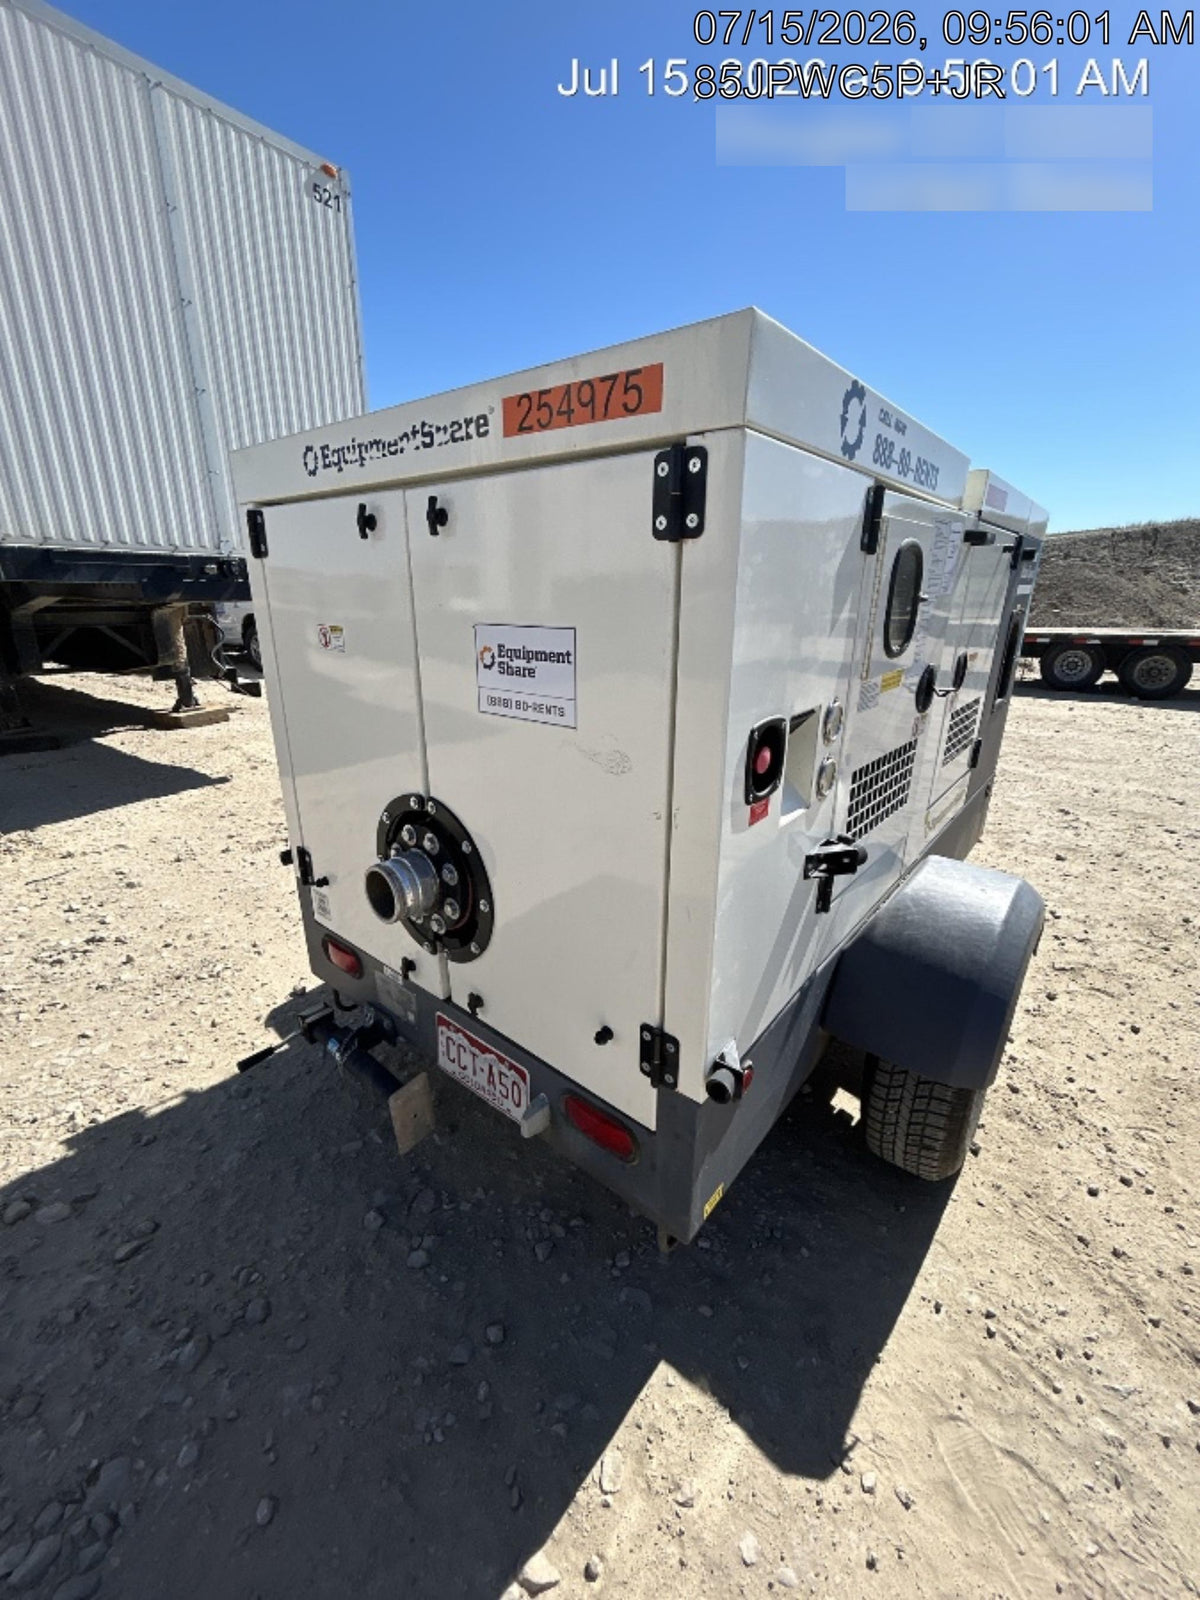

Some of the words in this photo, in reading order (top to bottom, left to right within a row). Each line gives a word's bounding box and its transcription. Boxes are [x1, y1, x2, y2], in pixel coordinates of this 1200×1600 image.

[312, 182, 341, 213] 521
[516, 369, 644, 433] 254975
[497, 643, 573, 664] Equipment
[497, 661, 536, 678] Share
